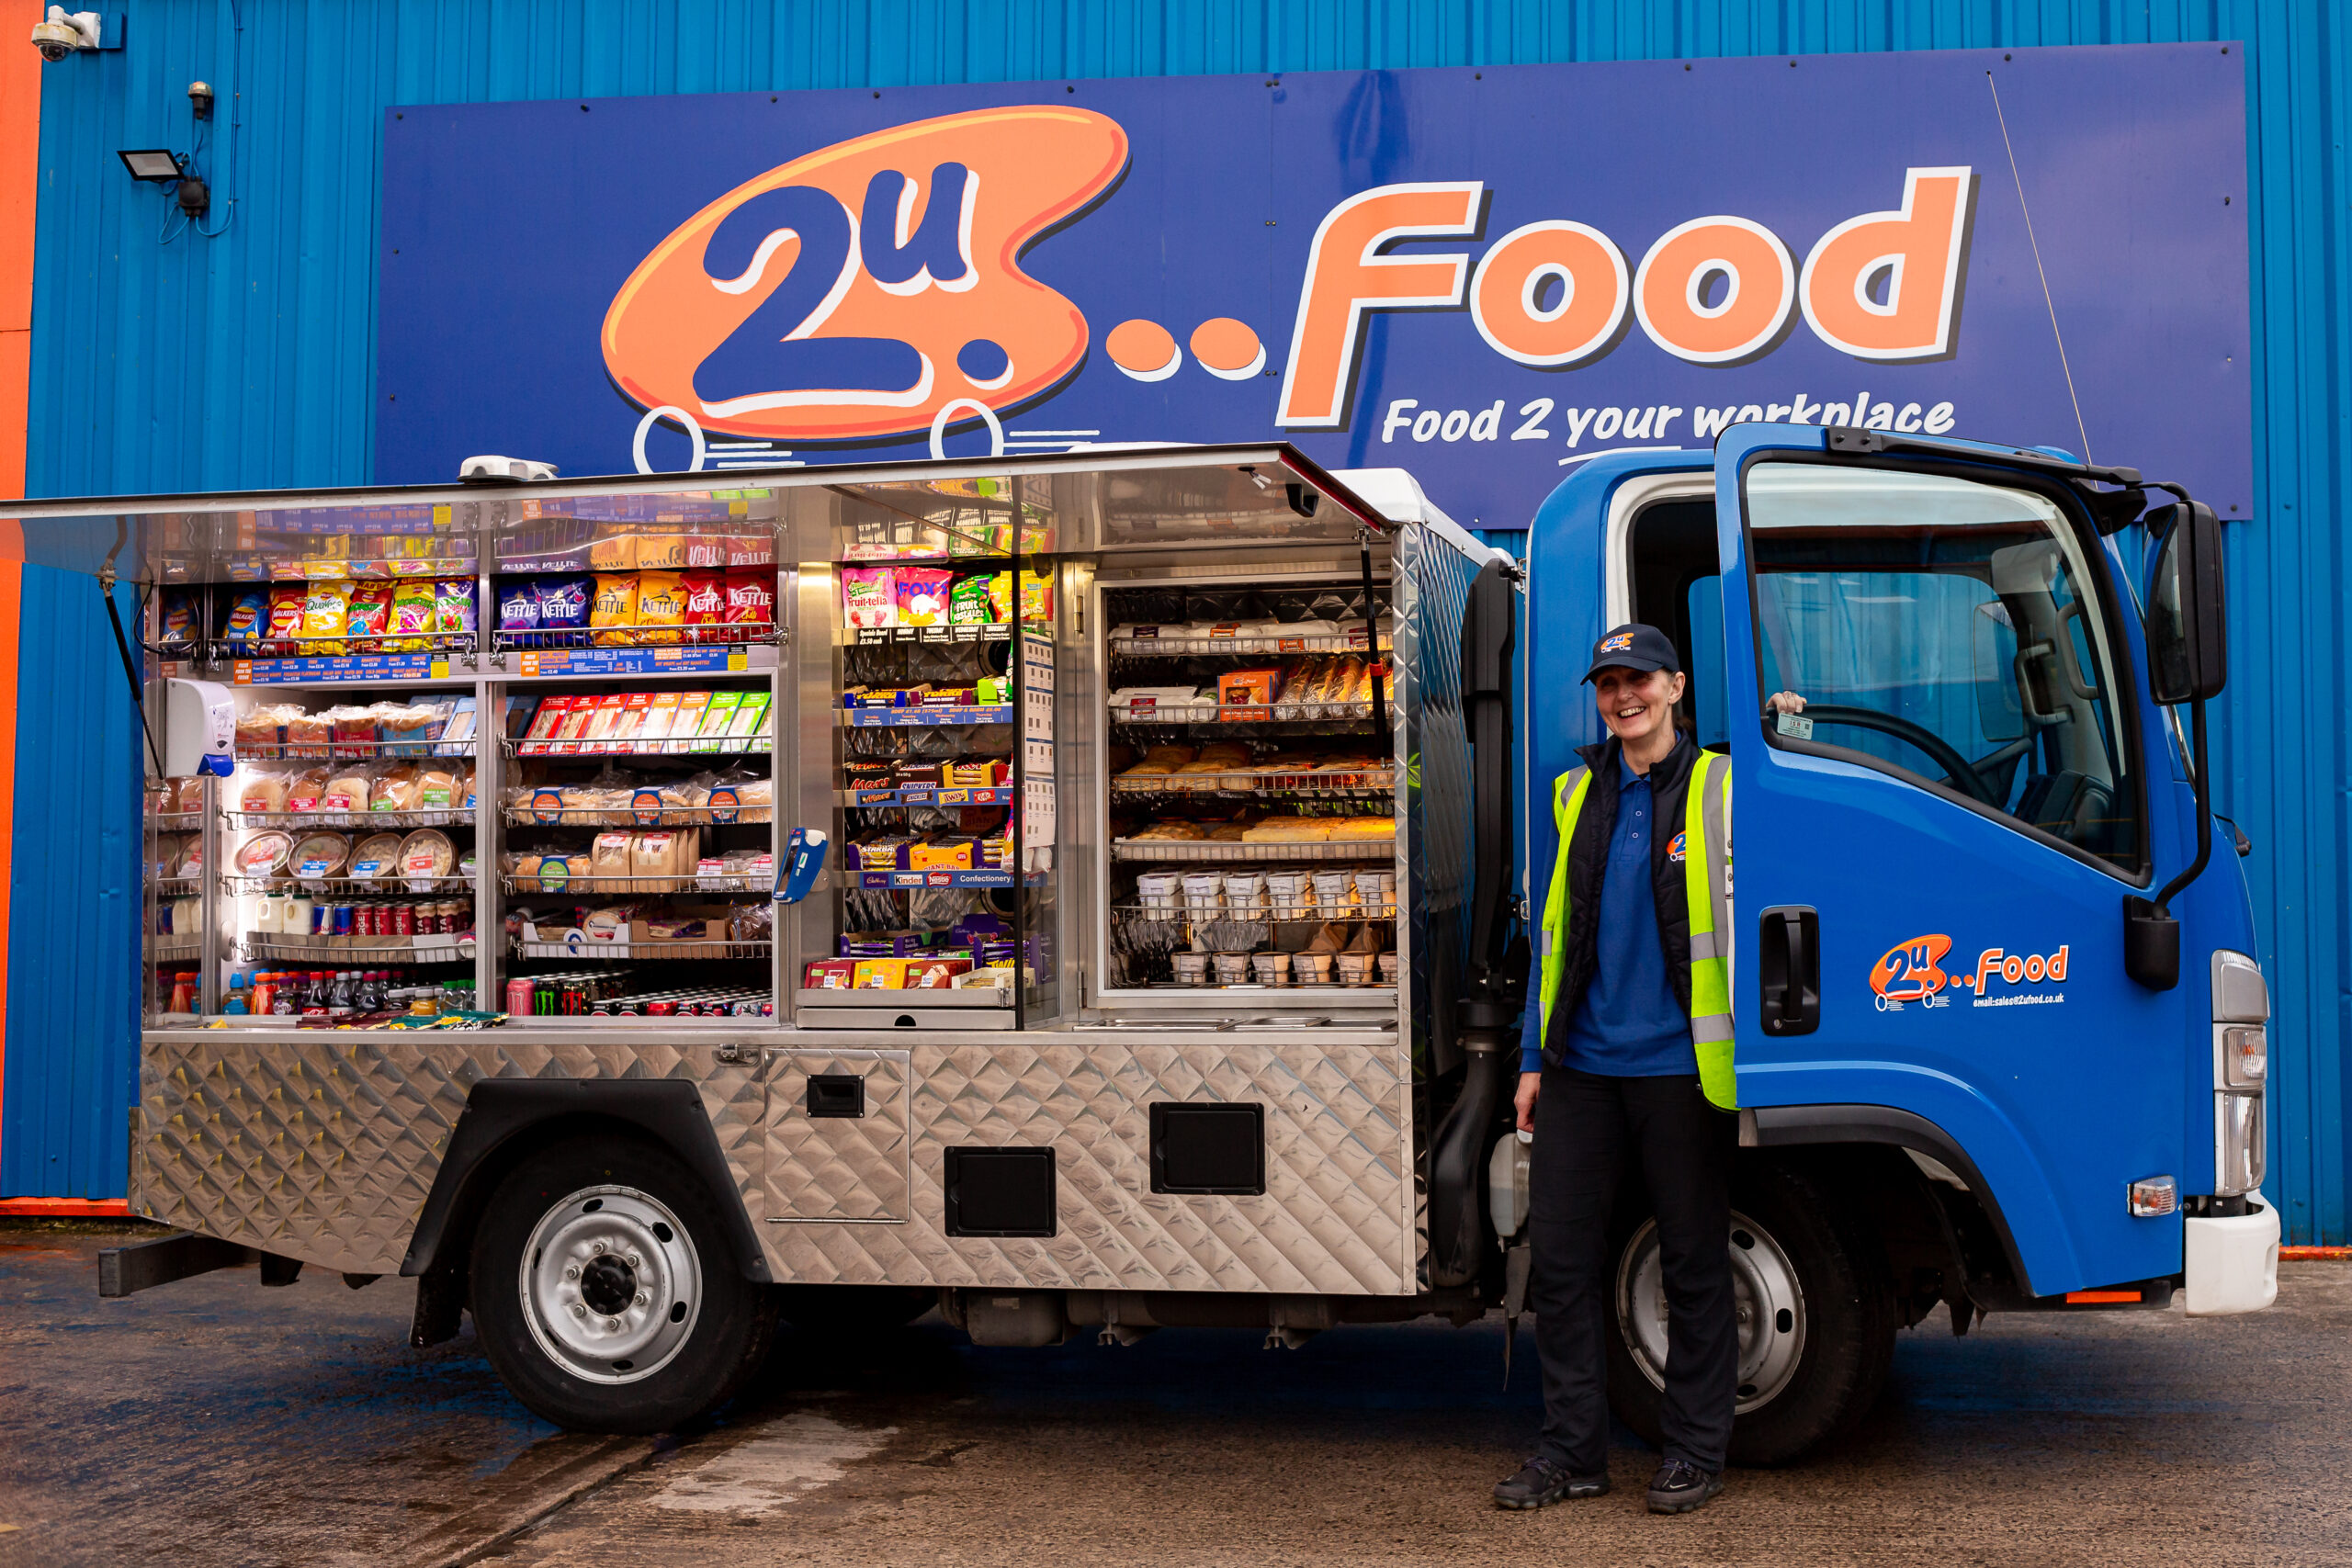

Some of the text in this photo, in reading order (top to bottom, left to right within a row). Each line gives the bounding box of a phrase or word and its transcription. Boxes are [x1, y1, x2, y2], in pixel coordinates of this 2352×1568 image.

[1275, 166, 1976, 428] Food
[1381, 399, 1502, 443] Food
[1511, 398, 1555, 441] 2
[1566, 400, 1685, 447] your
[730, 585, 773, 606] KETTLE
[899, 582, 948, 598] FOXS
[501, 598, 537, 619] KETTLE
[542, 598, 579, 619] KETTLE
[593, 594, 628, 614] KETTLE
[642, 594, 682, 615] KETTLE
[689, 592, 726, 613] KETTLE
[231, 611, 255, 621] WALKERS
[274, 607, 299, 617] WALKERS
[851, 777, 890, 791] Mars
[900, 781, 937, 790] SNICKERS
[865, 792, 891, 804] Mars
[907, 793, 928, 802] SNICKERS
[866, 875, 887, 886] Cadbury
[895, 874, 922, 886] Kinder
[960, 874, 1012, 884] Confectionery
[1973, 944, 2070, 996] Food
[1973, 992, 2064, 1008] email:sales@2ufood.co.uk
